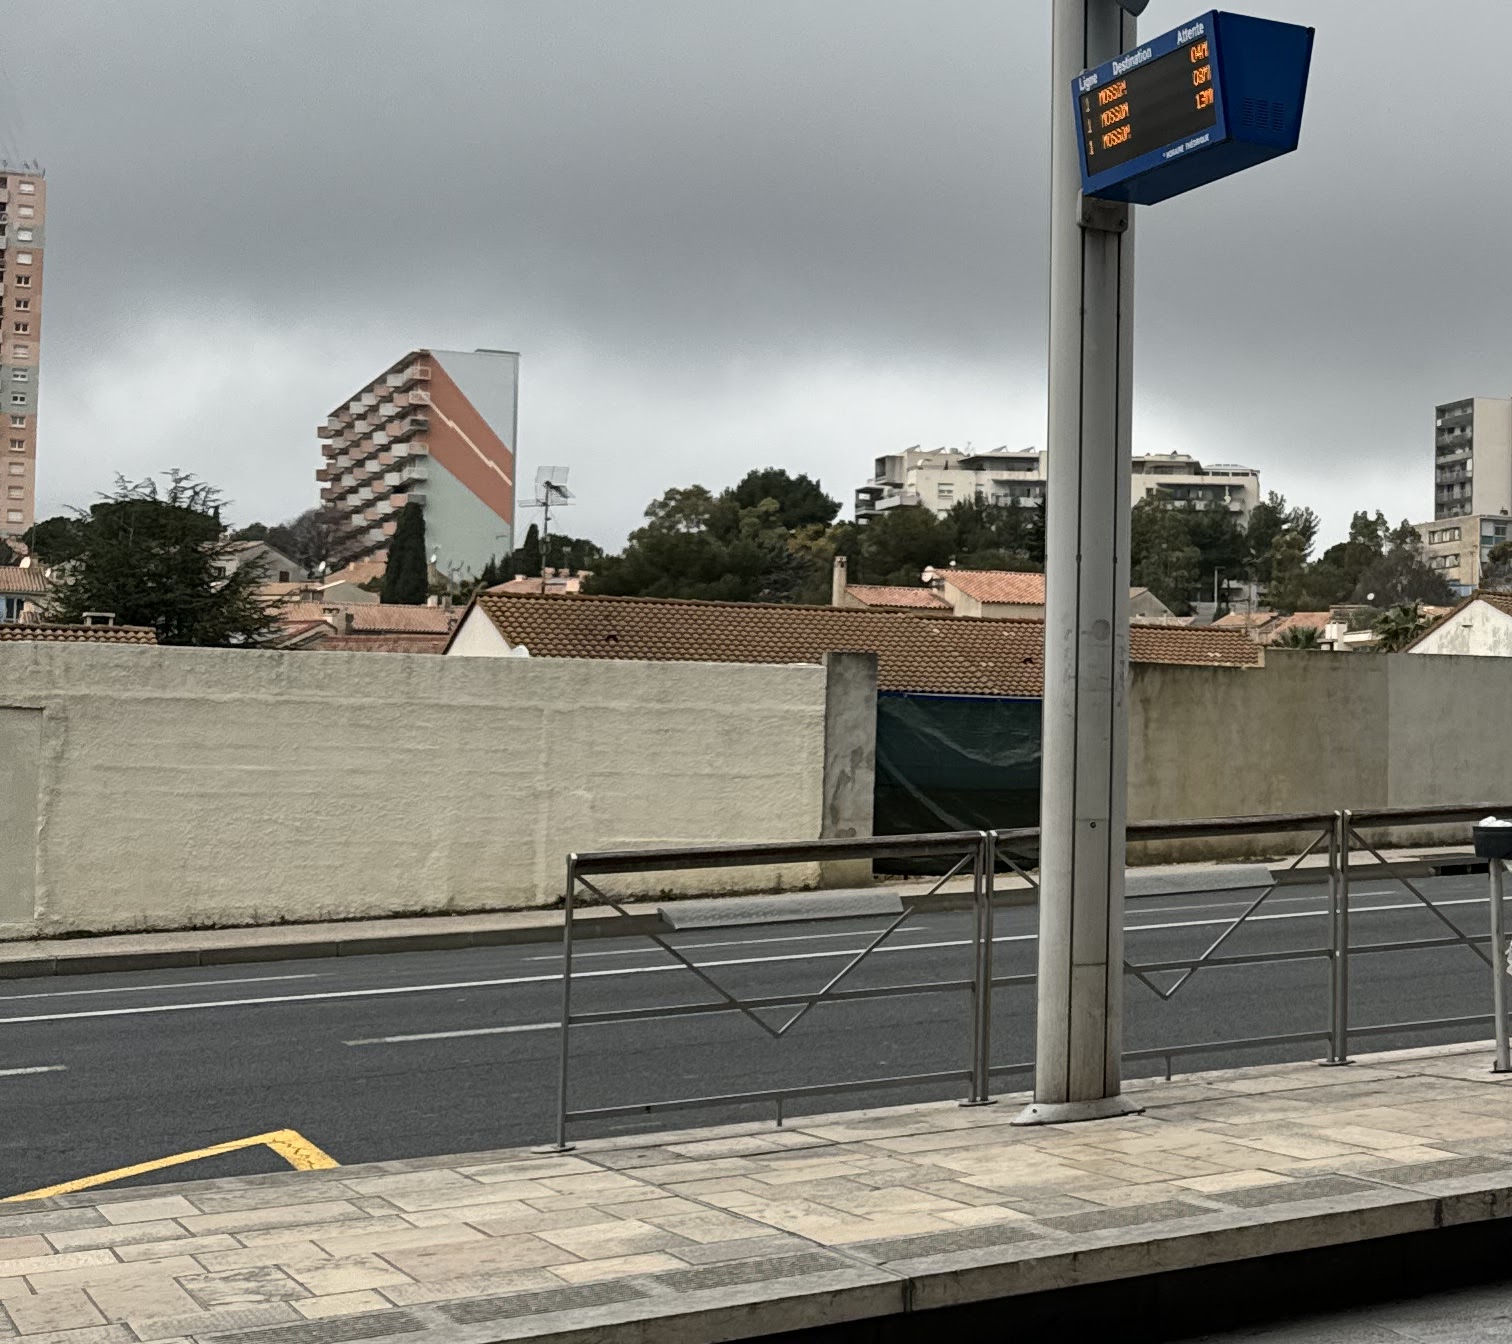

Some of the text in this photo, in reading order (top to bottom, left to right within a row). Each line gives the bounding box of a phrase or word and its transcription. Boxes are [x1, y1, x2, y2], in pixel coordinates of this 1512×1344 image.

[1079, 22, 1205, 91] Ligne Destination Attente
